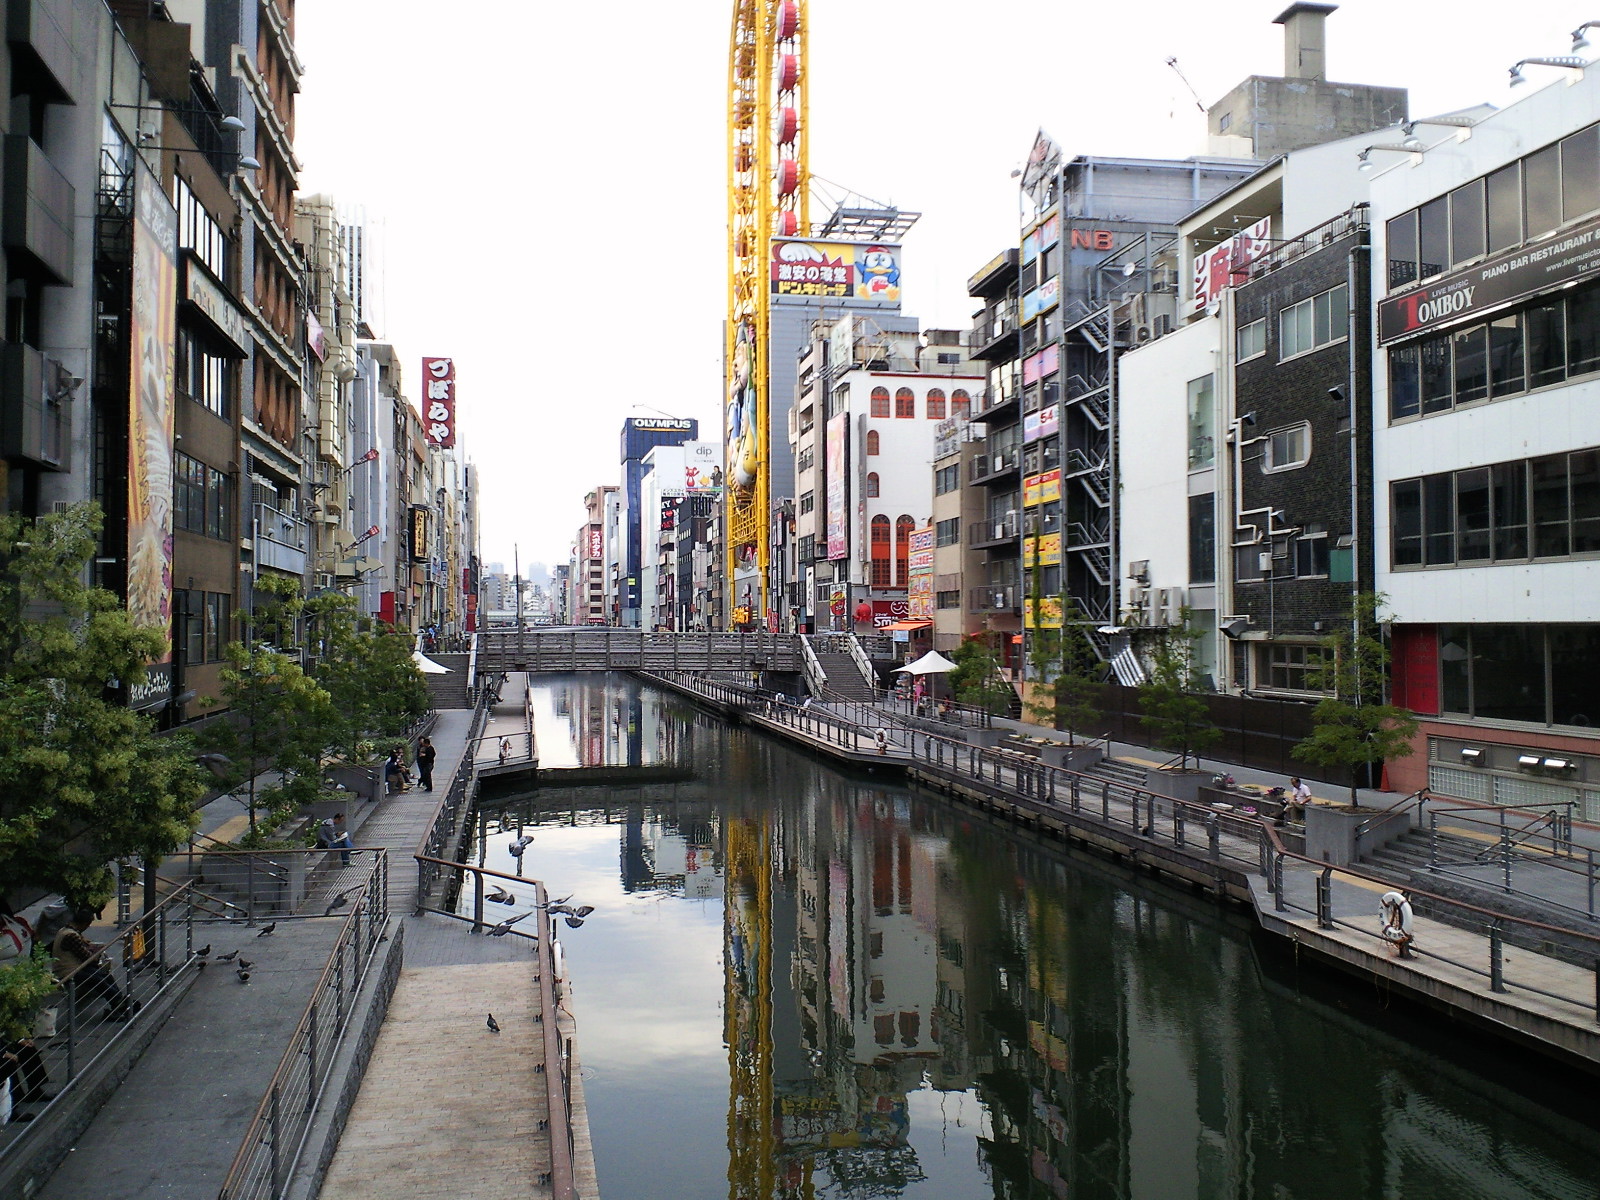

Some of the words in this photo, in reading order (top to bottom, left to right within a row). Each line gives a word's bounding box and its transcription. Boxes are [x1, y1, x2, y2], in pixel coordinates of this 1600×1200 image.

[1072, 229, 1113, 250] NB
[1482, 265, 1508, 280] PIANO
[1510, 256, 1529, 271] BAR
[1530, 231, 1593, 263] RESTAURANT
[1432, 287, 1447, 297] LIVE
[1447, 279, 1469, 292] MUSIC
[634, 418, 692, 429] OLYMPUS
[696, 446, 713, 457] dip
[592, 530, 602, 557] スポタカ
